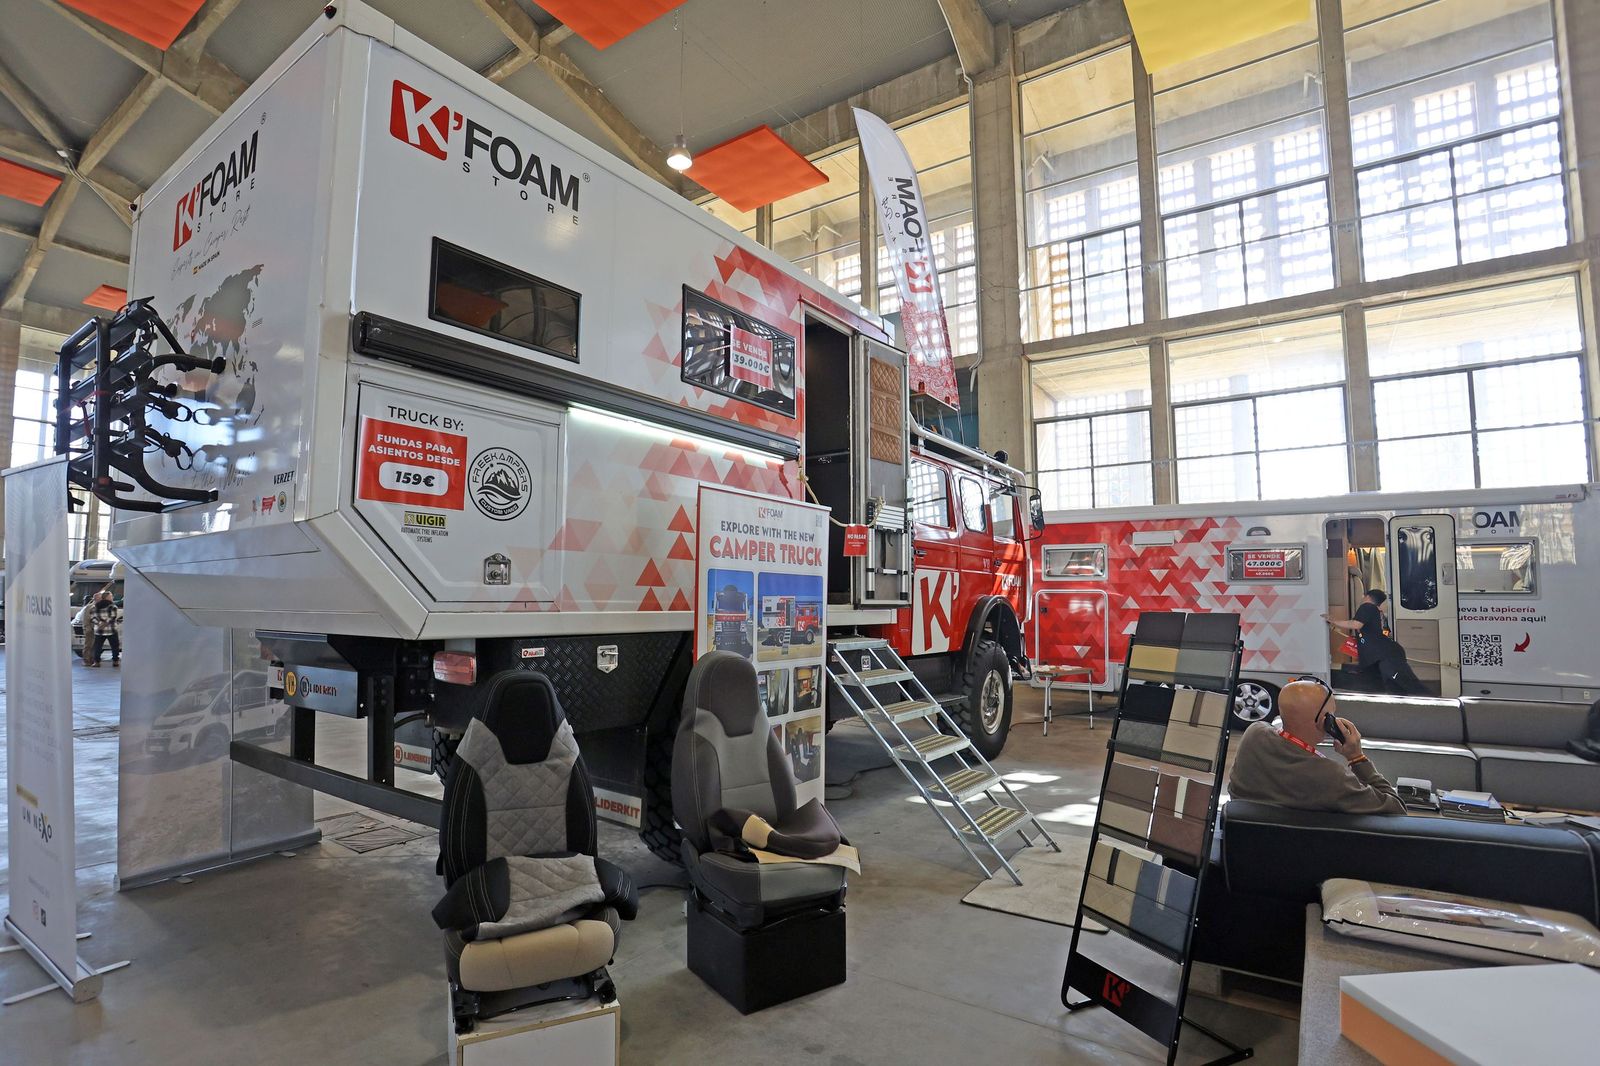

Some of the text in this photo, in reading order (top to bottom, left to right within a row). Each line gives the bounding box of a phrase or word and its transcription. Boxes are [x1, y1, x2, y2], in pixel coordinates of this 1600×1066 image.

[389, 80, 580, 212] K'FOAM
[173, 130, 259, 252] K'FOAM
[463, 161, 579, 226] STORE
[197, 178, 255, 233] STORE
[733, 353, 770, 374] 39.000€
[387, 405, 464, 431] TRUCK BY:
[368, 444, 461, 467] ASIENTOS DESDE
[377, 433, 454, 455] FUNDAS PARA
[273, 471, 295, 485] VERZET
[395, 470, 436, 488] 159€
[721, 520, 815, 542] EXPLORE WITH THE NEW
[709, 535, 823, 567] CAMPER TRUCK
